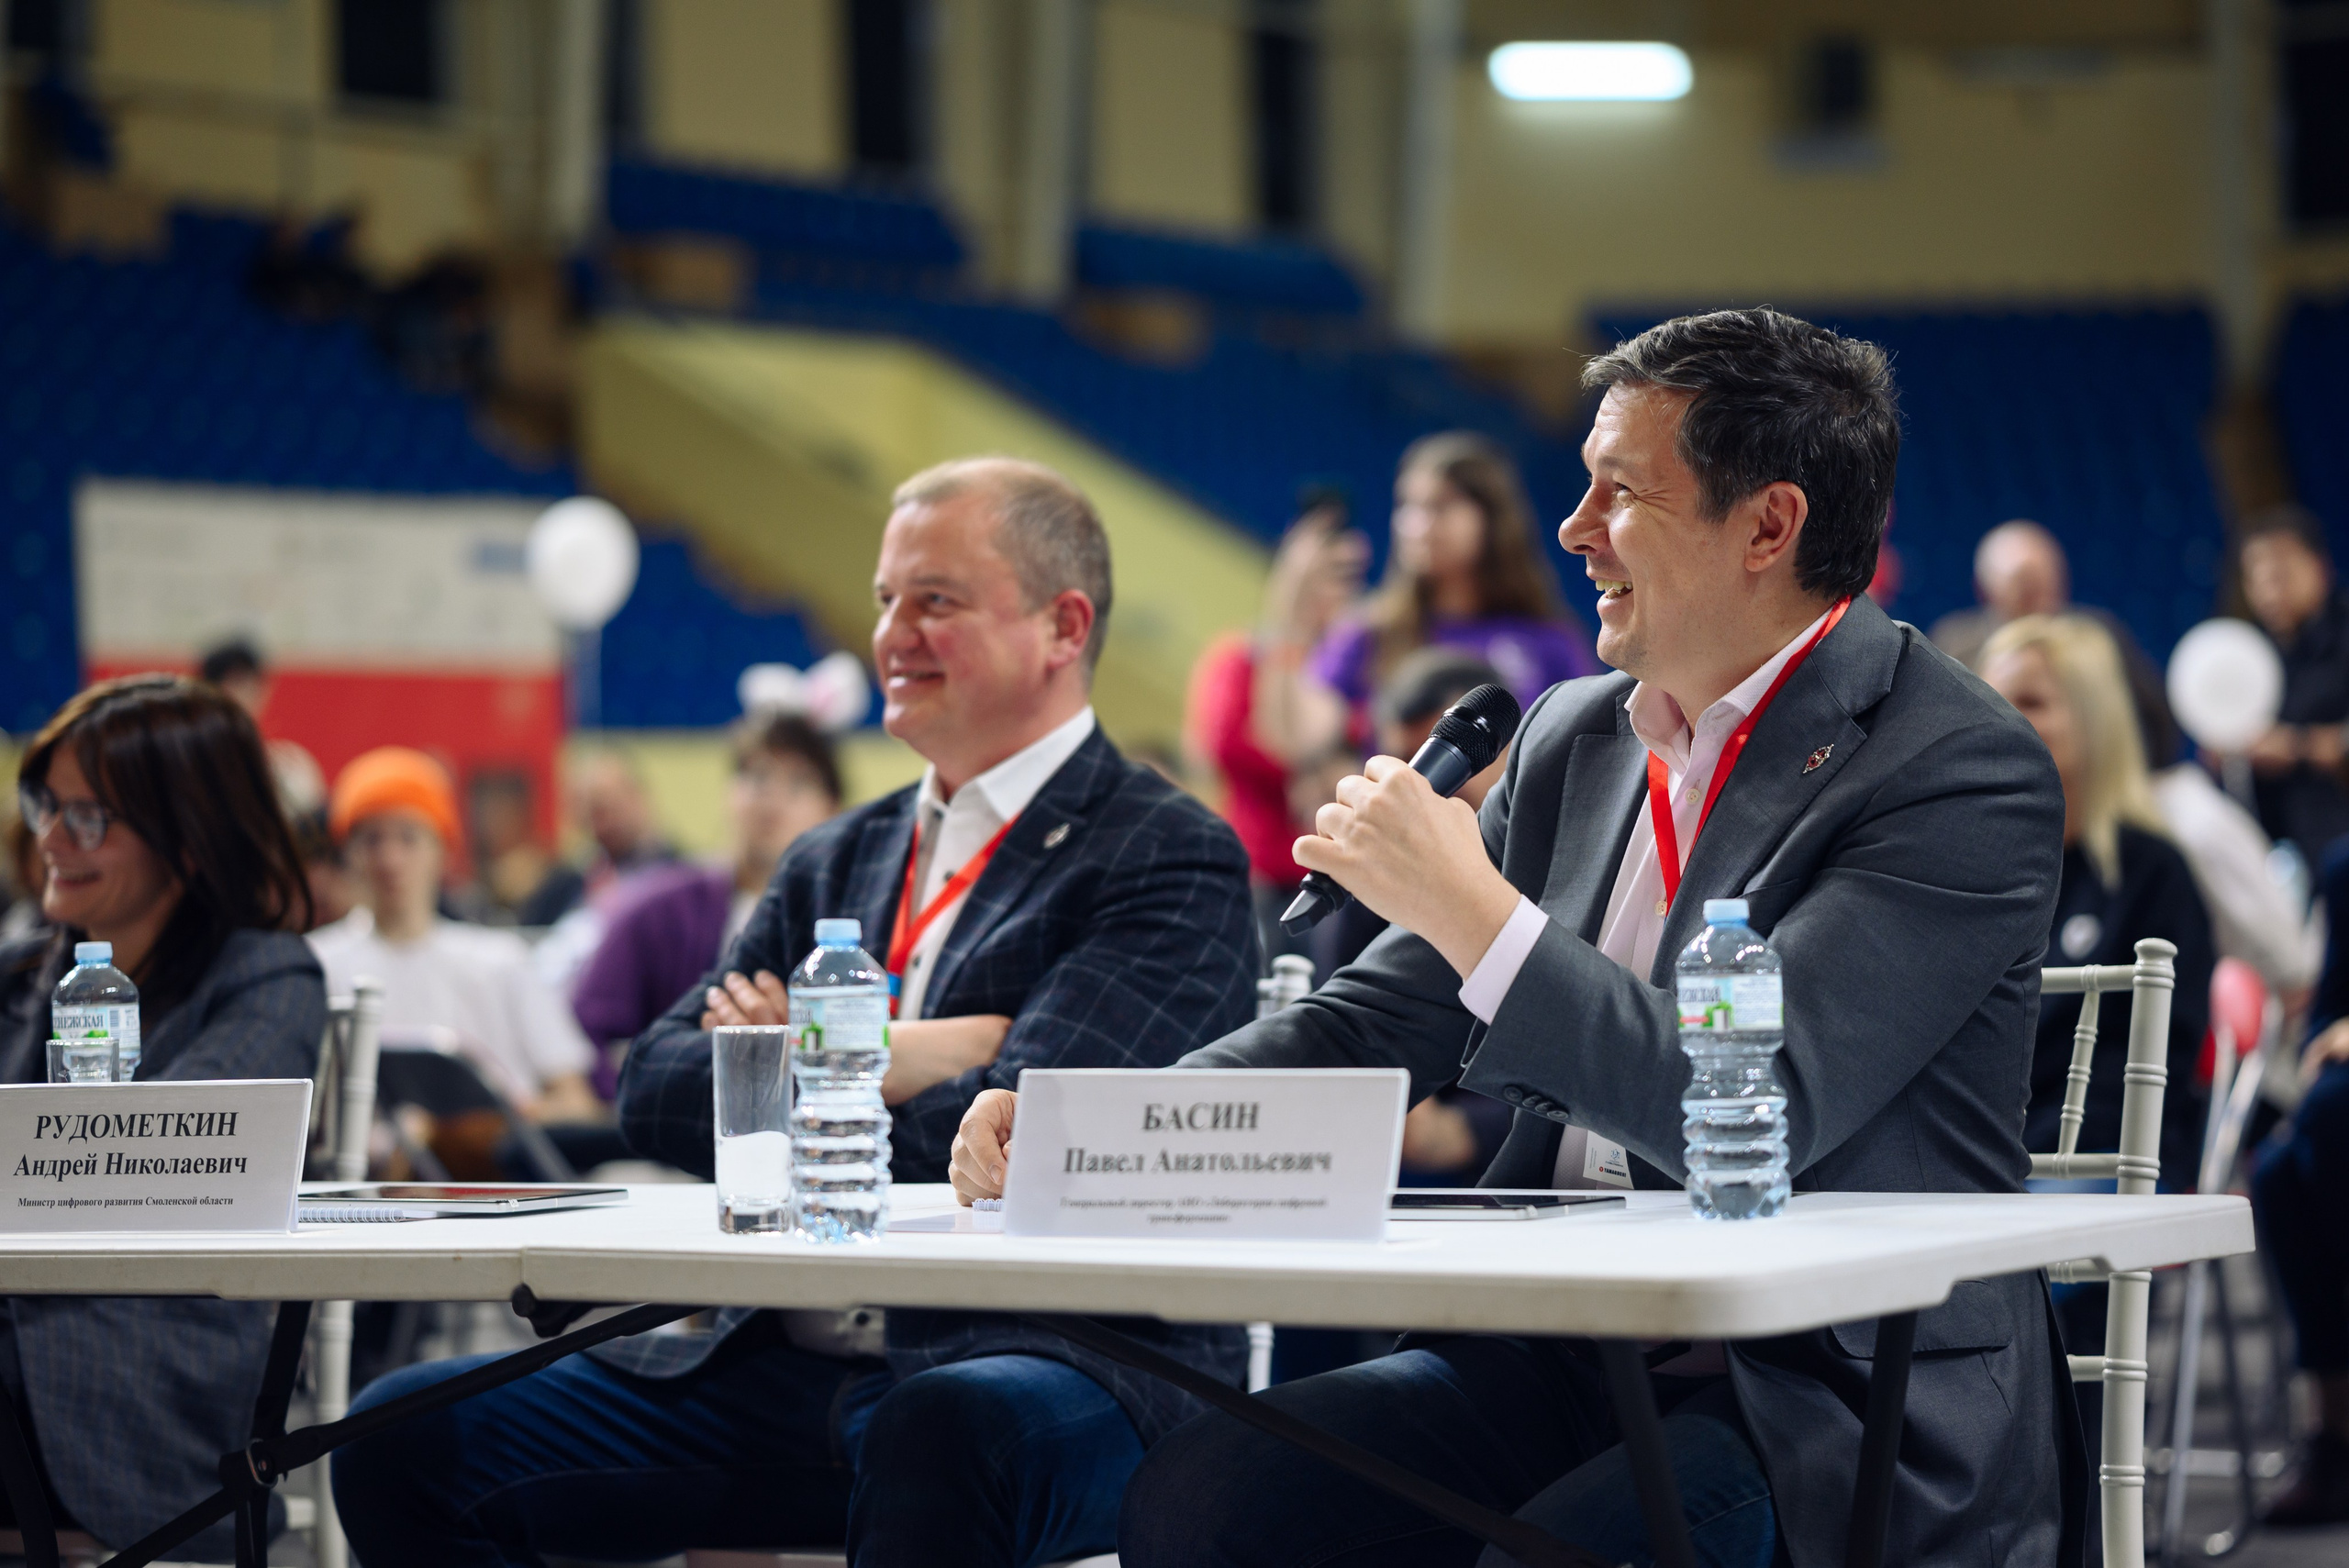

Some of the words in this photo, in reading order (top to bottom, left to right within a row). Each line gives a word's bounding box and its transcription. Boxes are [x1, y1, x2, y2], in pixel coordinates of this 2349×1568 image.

[34, 1111, 239, 1144] РУДОМЕТКИН
[1141, 1102, 1260, 1131] БАСИН
[14, 1152, 98, 1182] Андрей
[104, 1152, 248, 1175] Николаевич
[1063, 1146, 1144, 1173] Павел
[1151, 1147, 1331, 1173] Анатольевич
[17, 1197, 56, 1208] Министр
[57, 1196, 103, 1208] цифрового
[104, 1198, 143, 1208] развития
[145, 1195, 197, 1206] Смоленской
[199, 1195, 234, 1206] области
